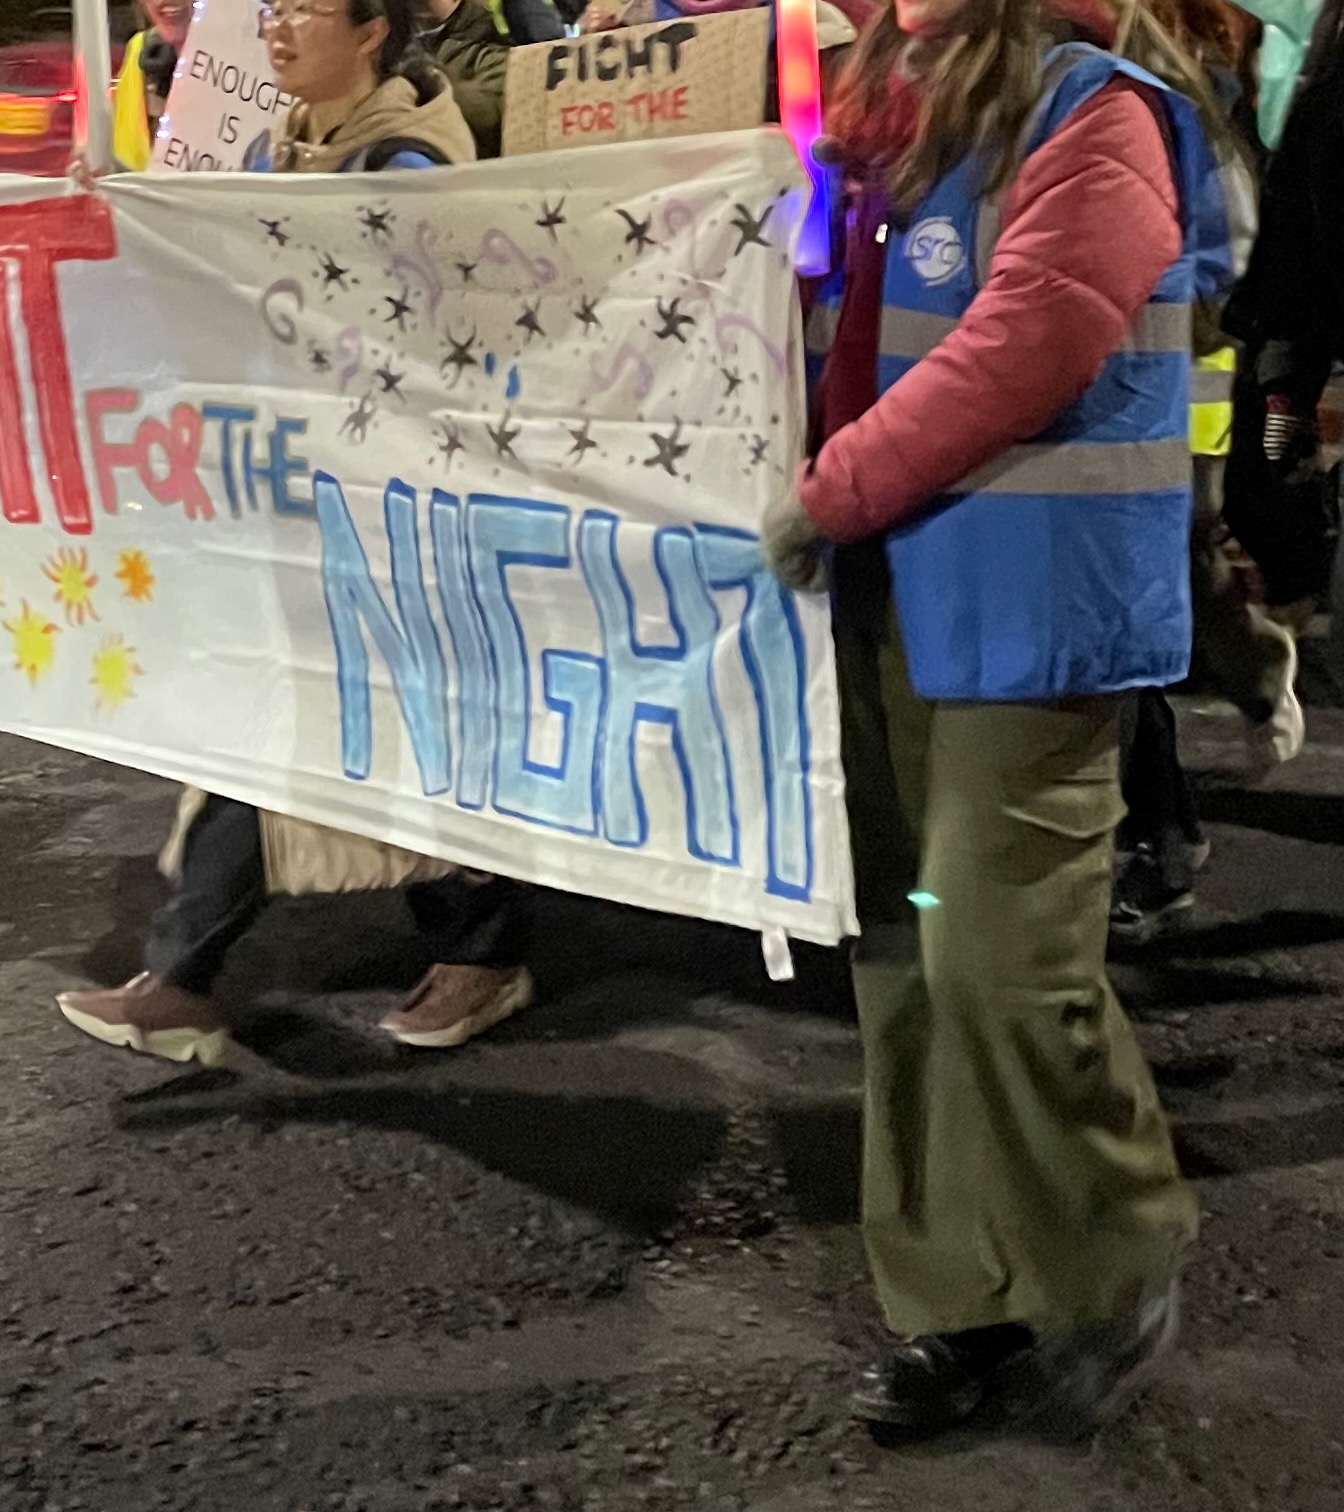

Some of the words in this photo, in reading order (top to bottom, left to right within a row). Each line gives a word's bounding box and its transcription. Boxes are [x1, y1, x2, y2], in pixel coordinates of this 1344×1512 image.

[545, 22, 699, 92] FIGHT
[218, 112, 241, 144] IS
[560, 101, 616, 137] FOR
[627, 86, 690, 124] THE
[84, 387, 216, 521] FOR
[202, 400, 318, 519] THE
[312, 469, 813, 903] NIGHT
